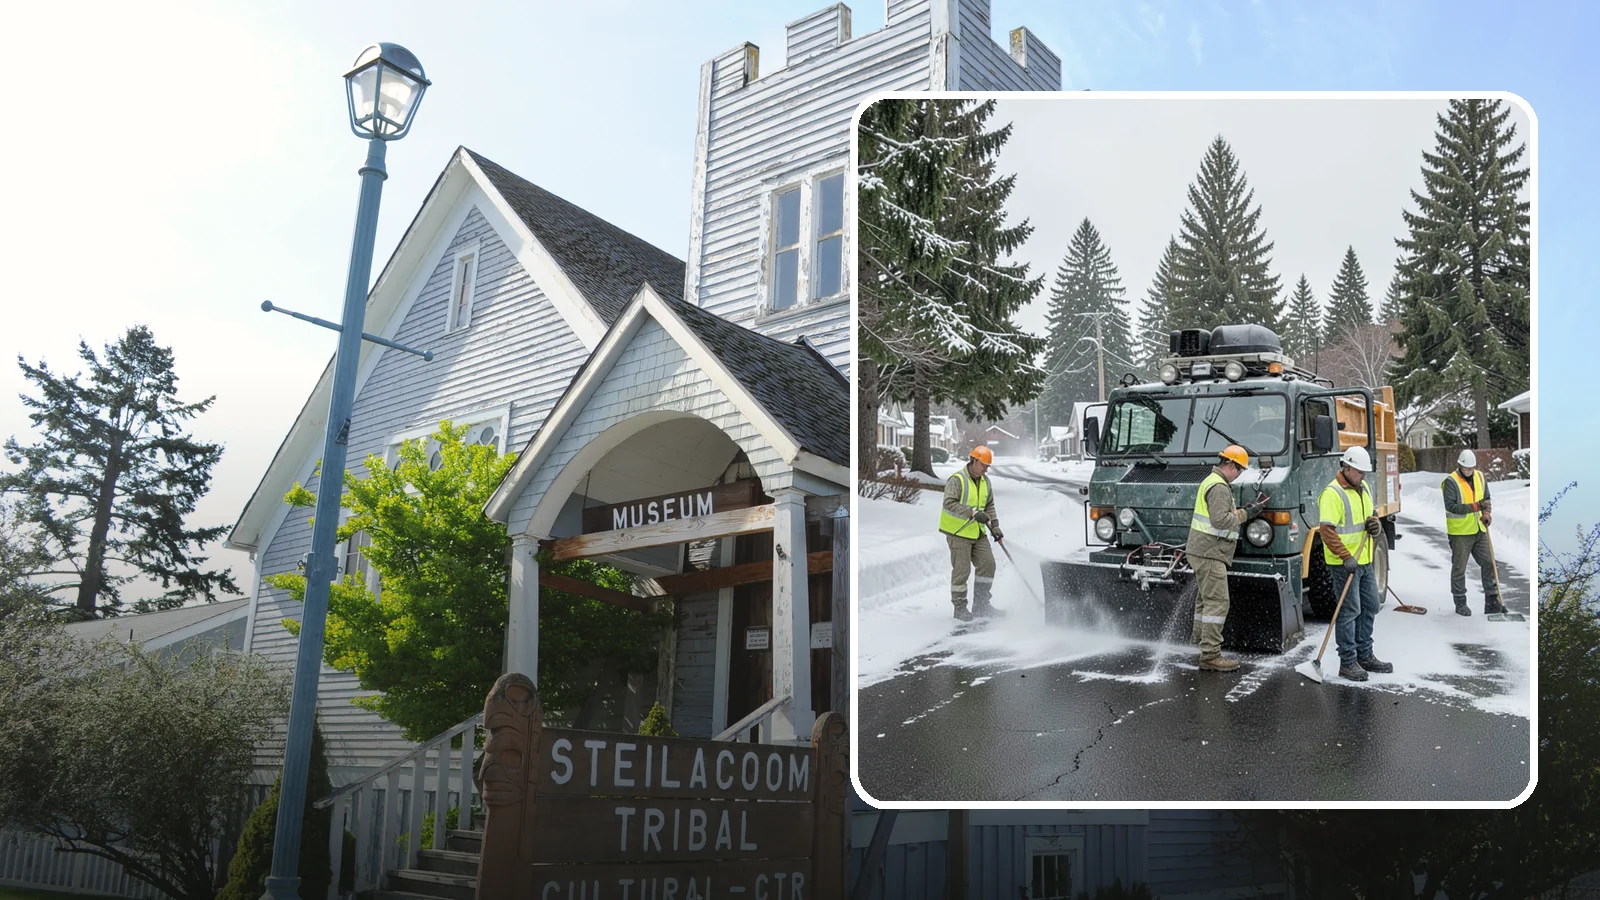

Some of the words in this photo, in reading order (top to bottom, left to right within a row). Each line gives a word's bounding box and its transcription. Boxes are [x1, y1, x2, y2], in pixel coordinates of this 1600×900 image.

[613, 491, 714, 530] MUSEUM
[550, 738, 809, 792] STEILACOOM
[614, 806, 757, 851] TRIBAL
